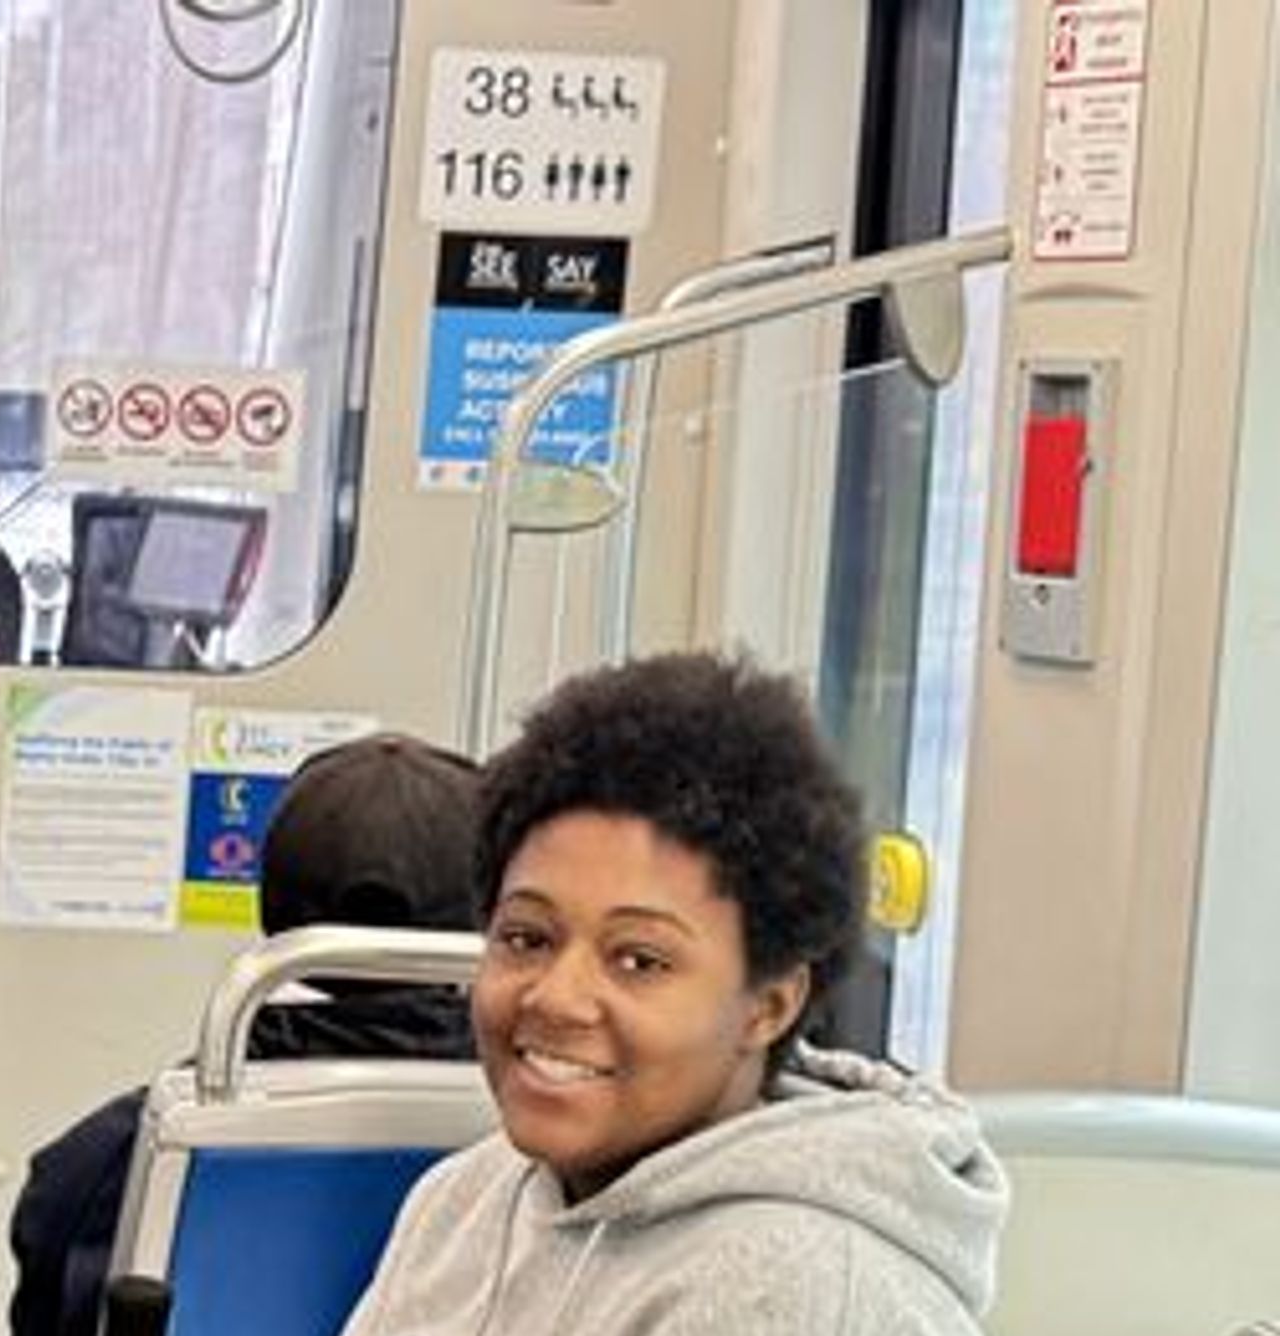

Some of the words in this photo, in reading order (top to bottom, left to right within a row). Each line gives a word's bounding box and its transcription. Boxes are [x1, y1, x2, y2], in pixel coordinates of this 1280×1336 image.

[464, 65, 532, 119] 38
[436, 148, 525, 201] 116
[547, 254, 600, 281] SAY
